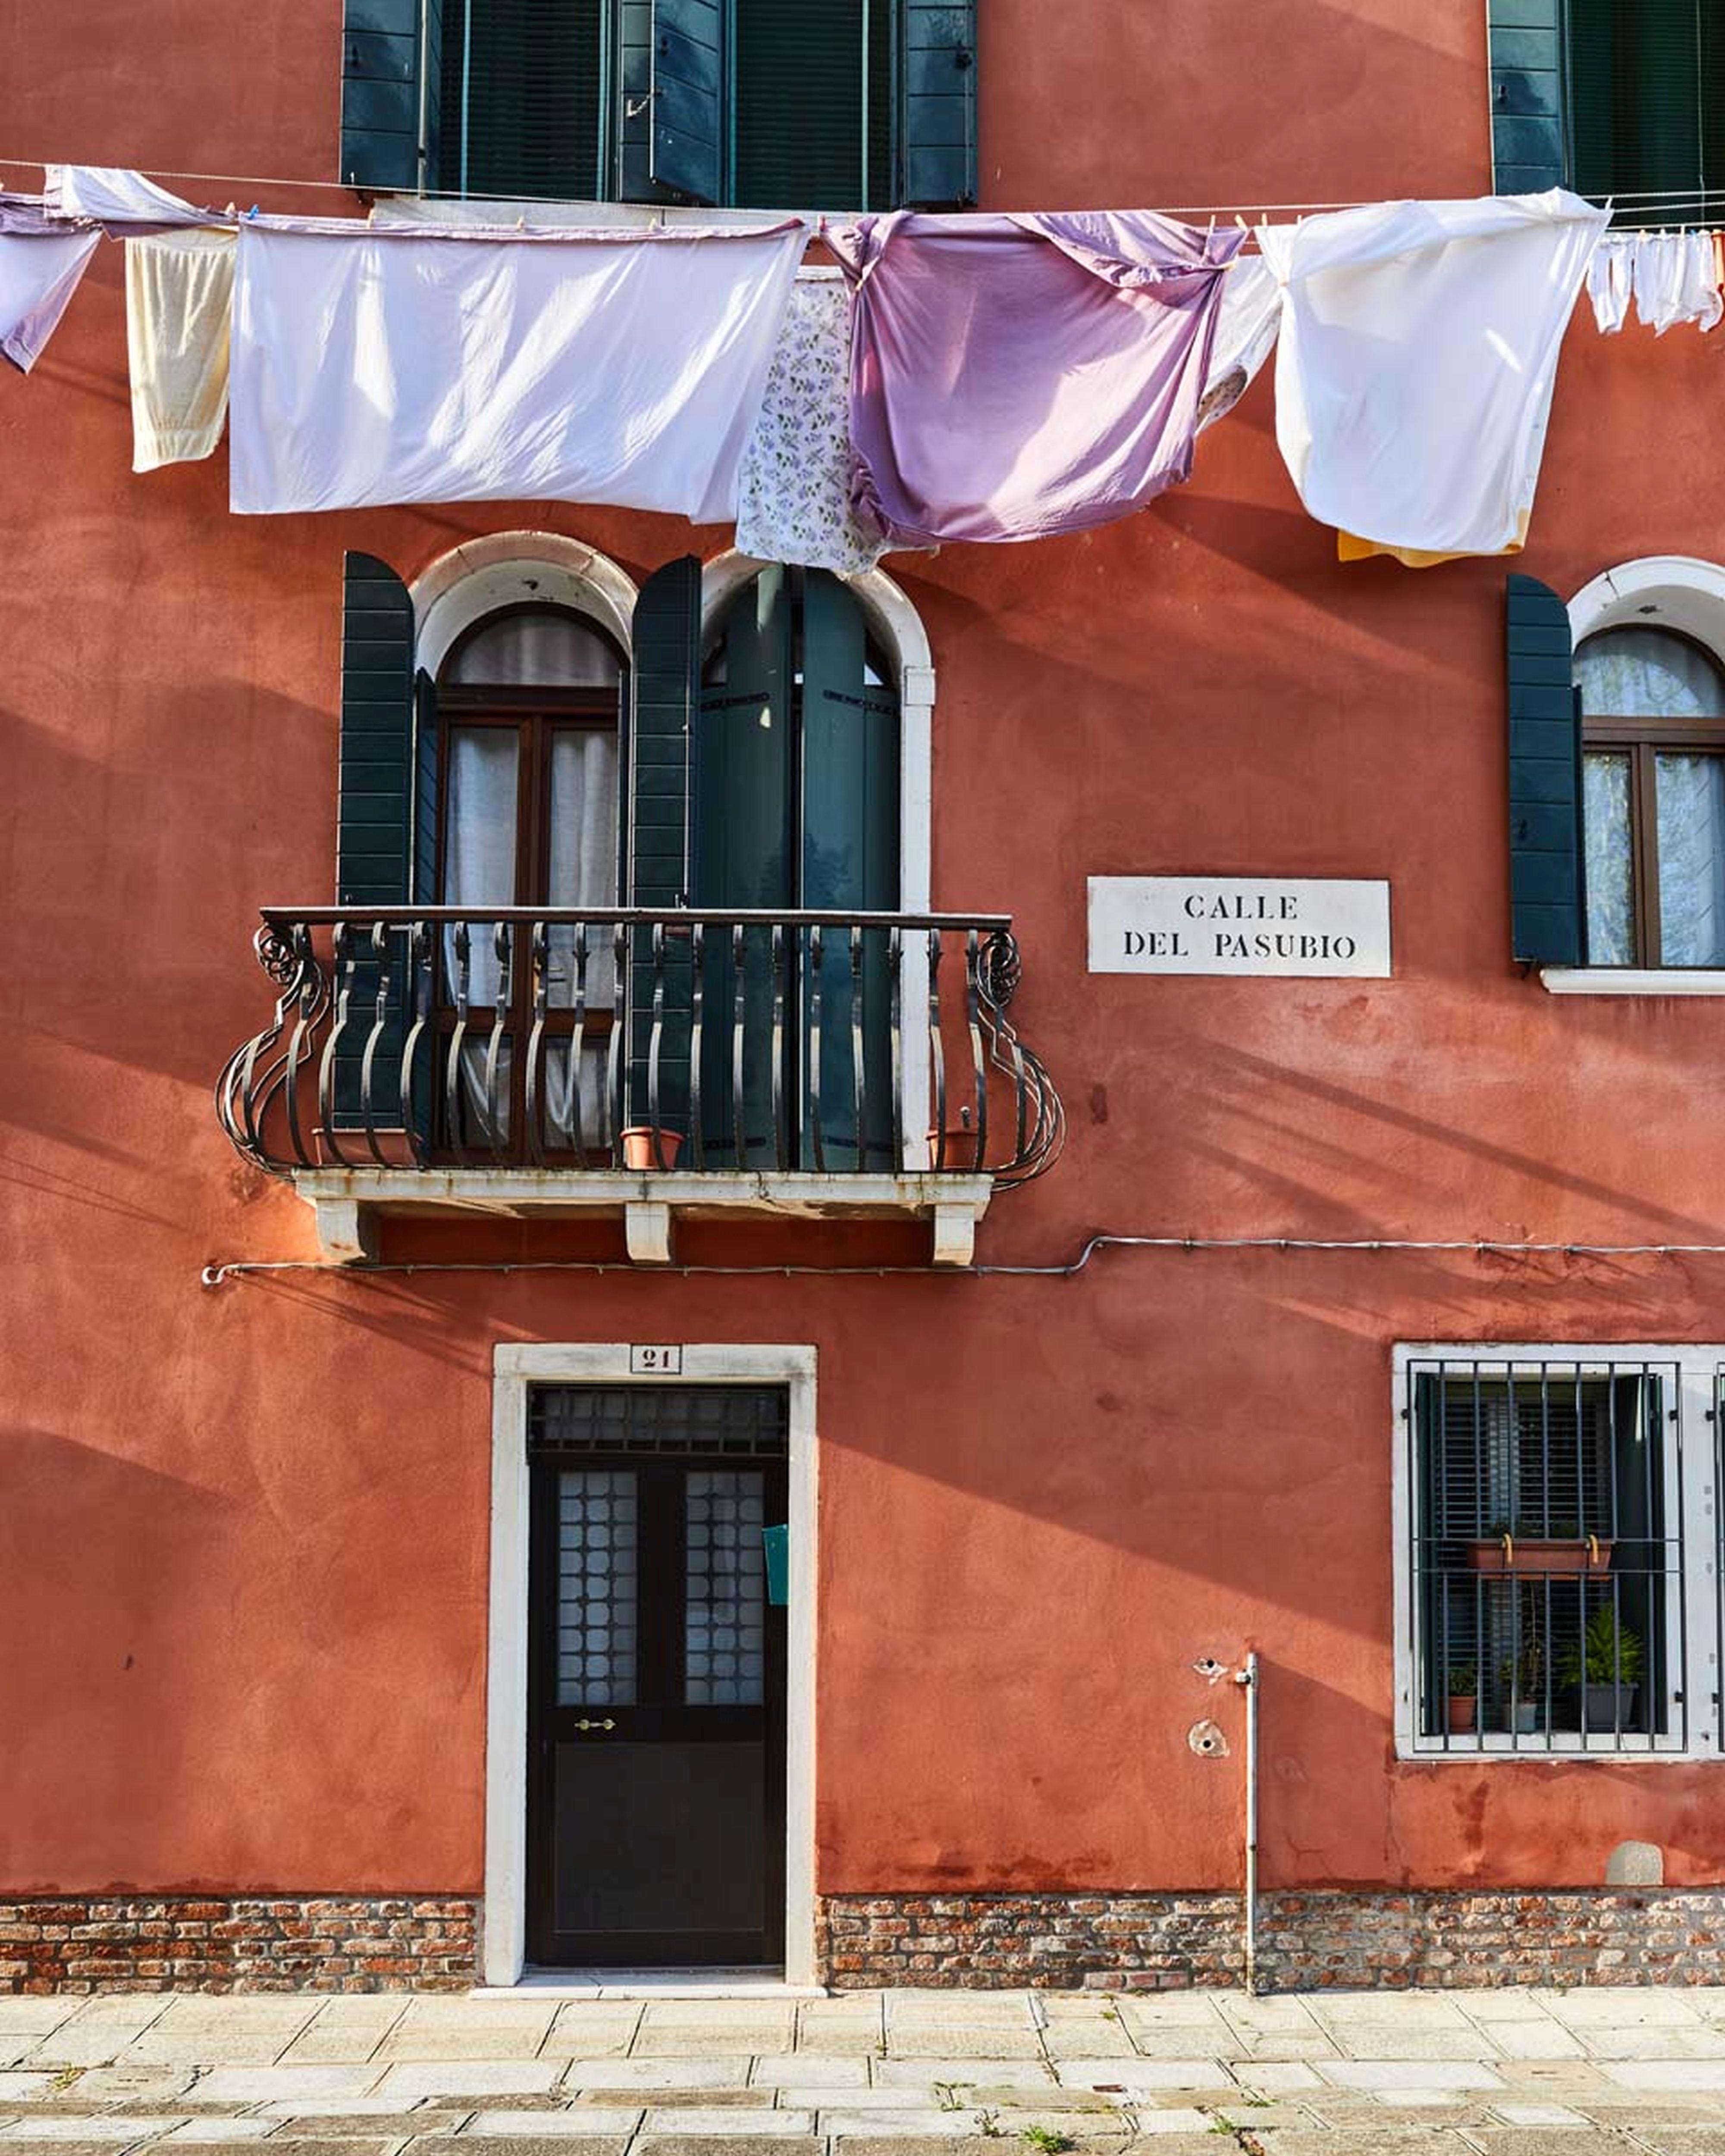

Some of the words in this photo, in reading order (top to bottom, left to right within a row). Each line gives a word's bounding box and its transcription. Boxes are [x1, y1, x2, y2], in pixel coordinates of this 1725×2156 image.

[1184, 895, 1298, 919] CALLE
[1124, 931, 1189, 956] DEL
[1215, 933, 1356, 959] PASUBIO
[642, 1349, 669, 1368] 21
